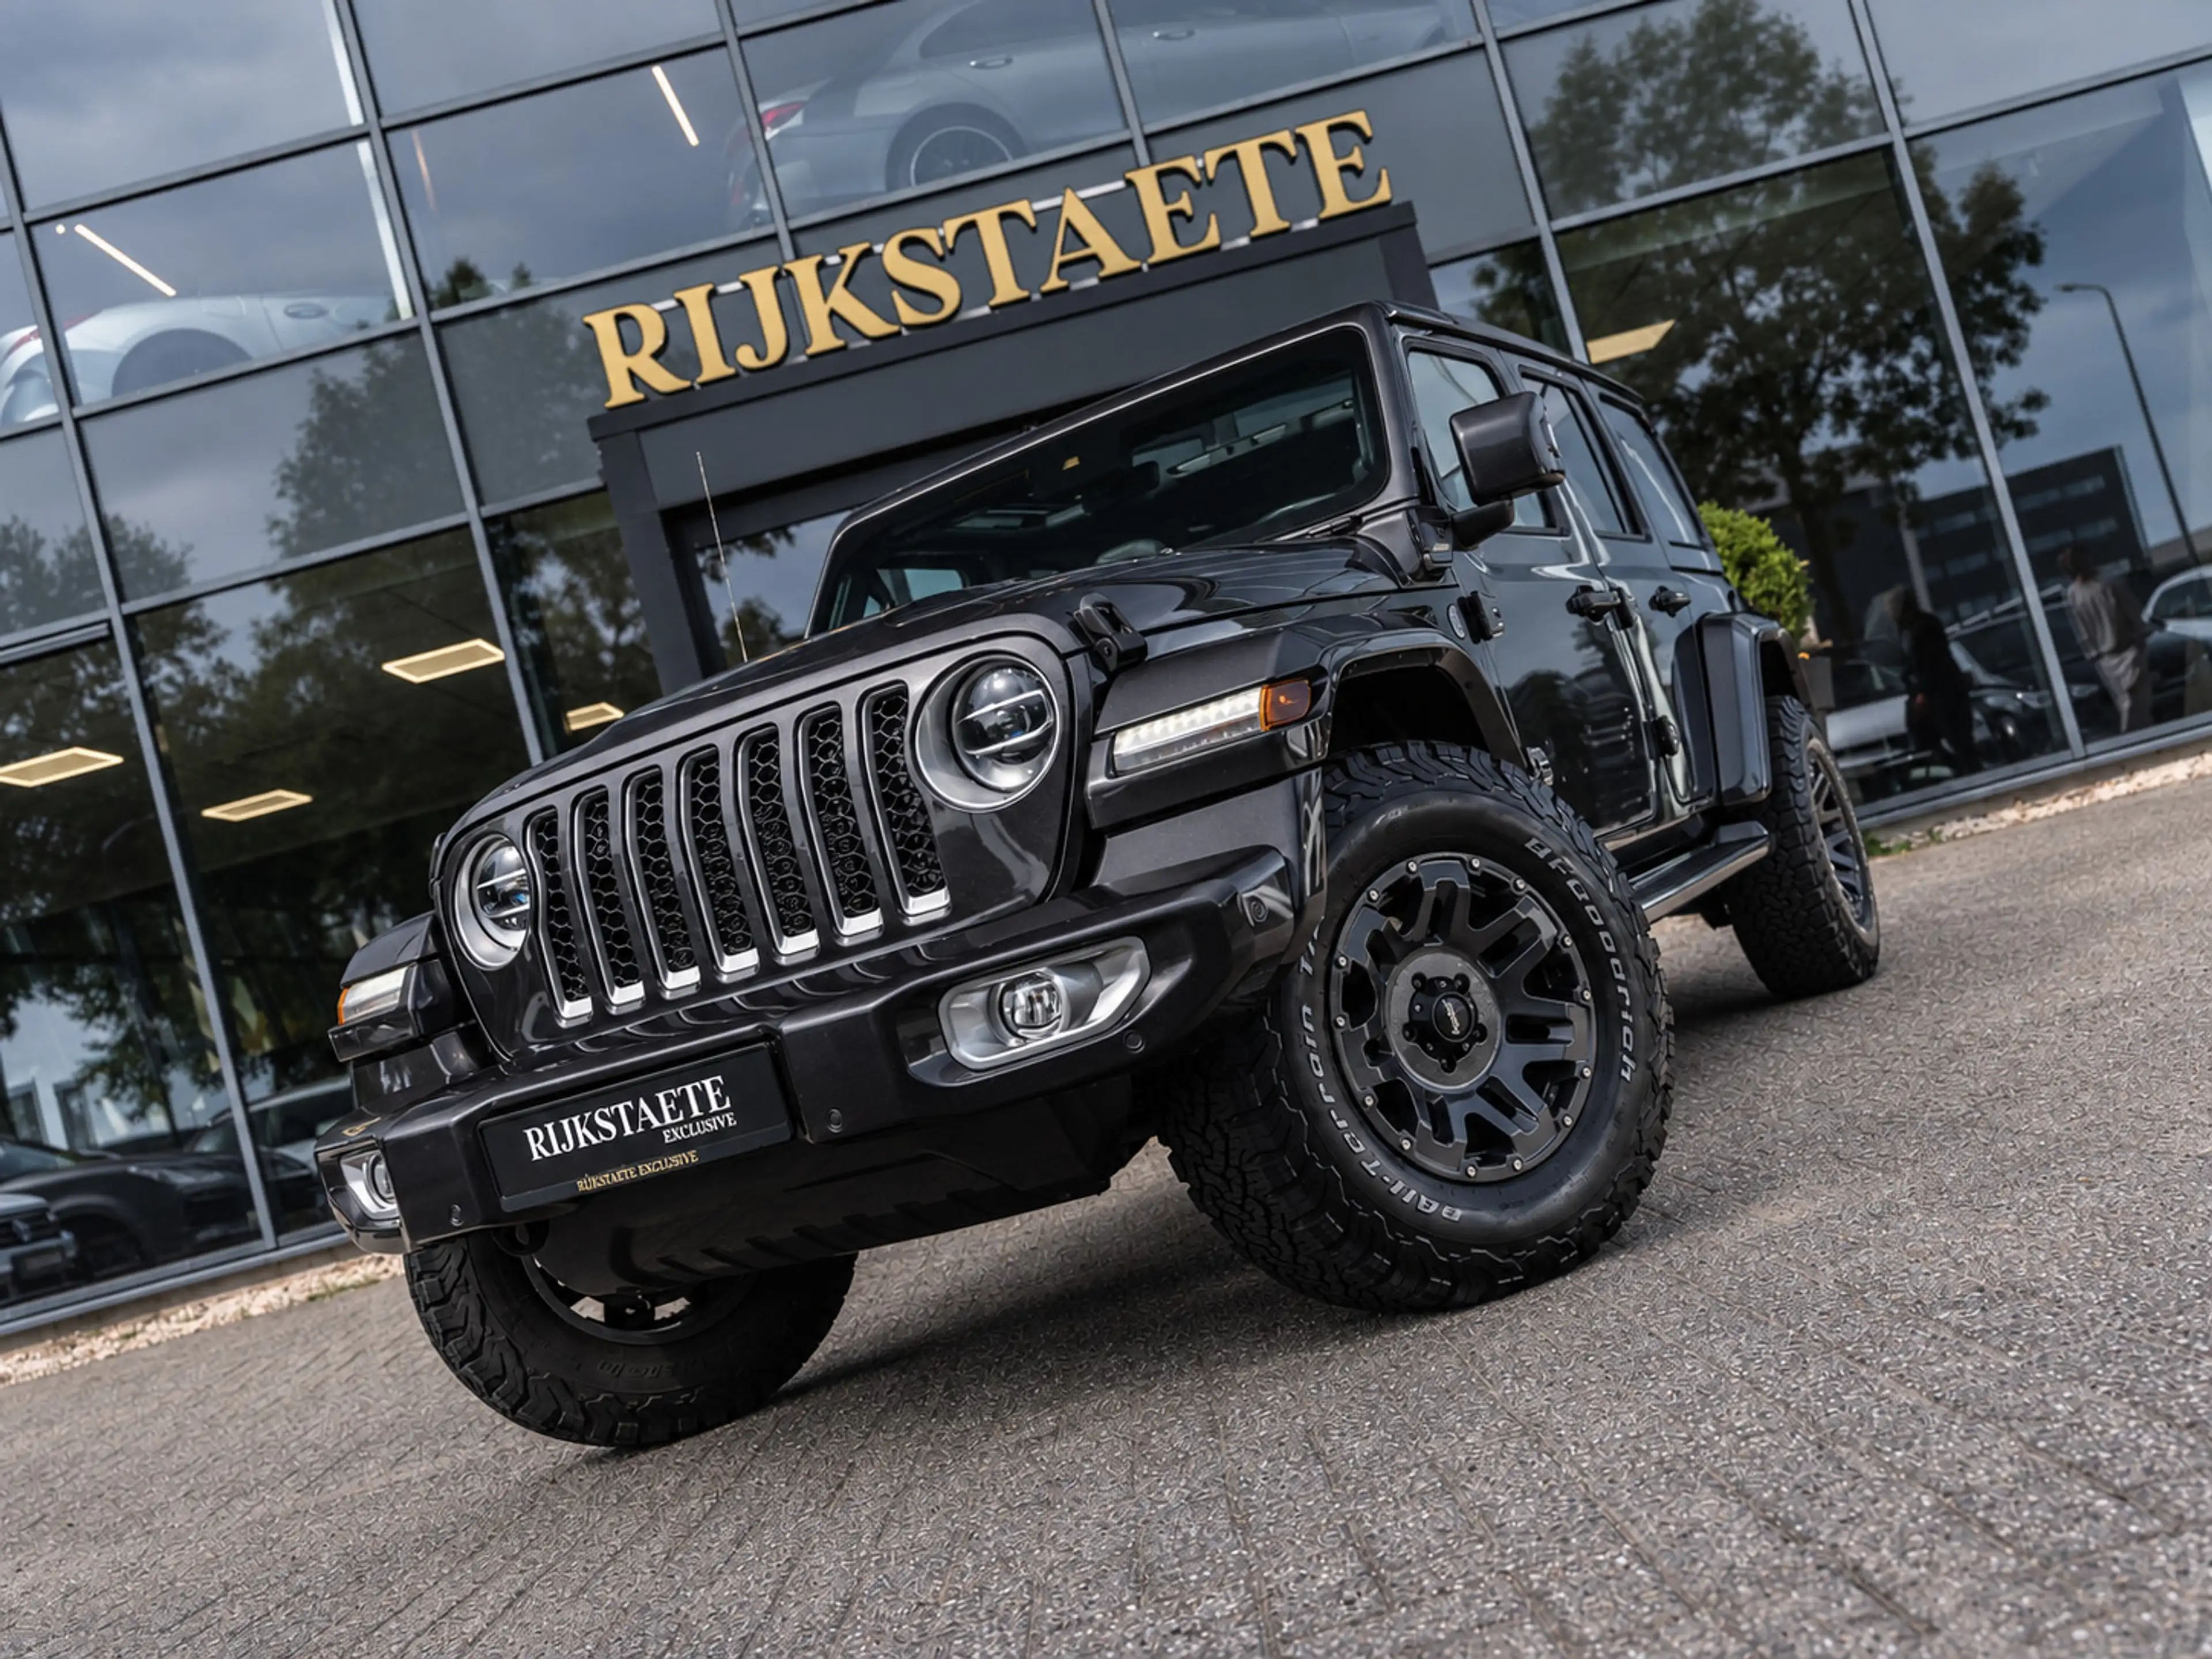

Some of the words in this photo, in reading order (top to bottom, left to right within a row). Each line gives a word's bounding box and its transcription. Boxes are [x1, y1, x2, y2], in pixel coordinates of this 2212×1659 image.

[582, 111, 1392, 409] RIJKSTAETE
[522, 1075, 732, 1162] RIJKSTAETE
[662, 1112, 737, 1144] EXCLUSIVE
[638, 1150, 699, 1176] EXCLUSIVE
